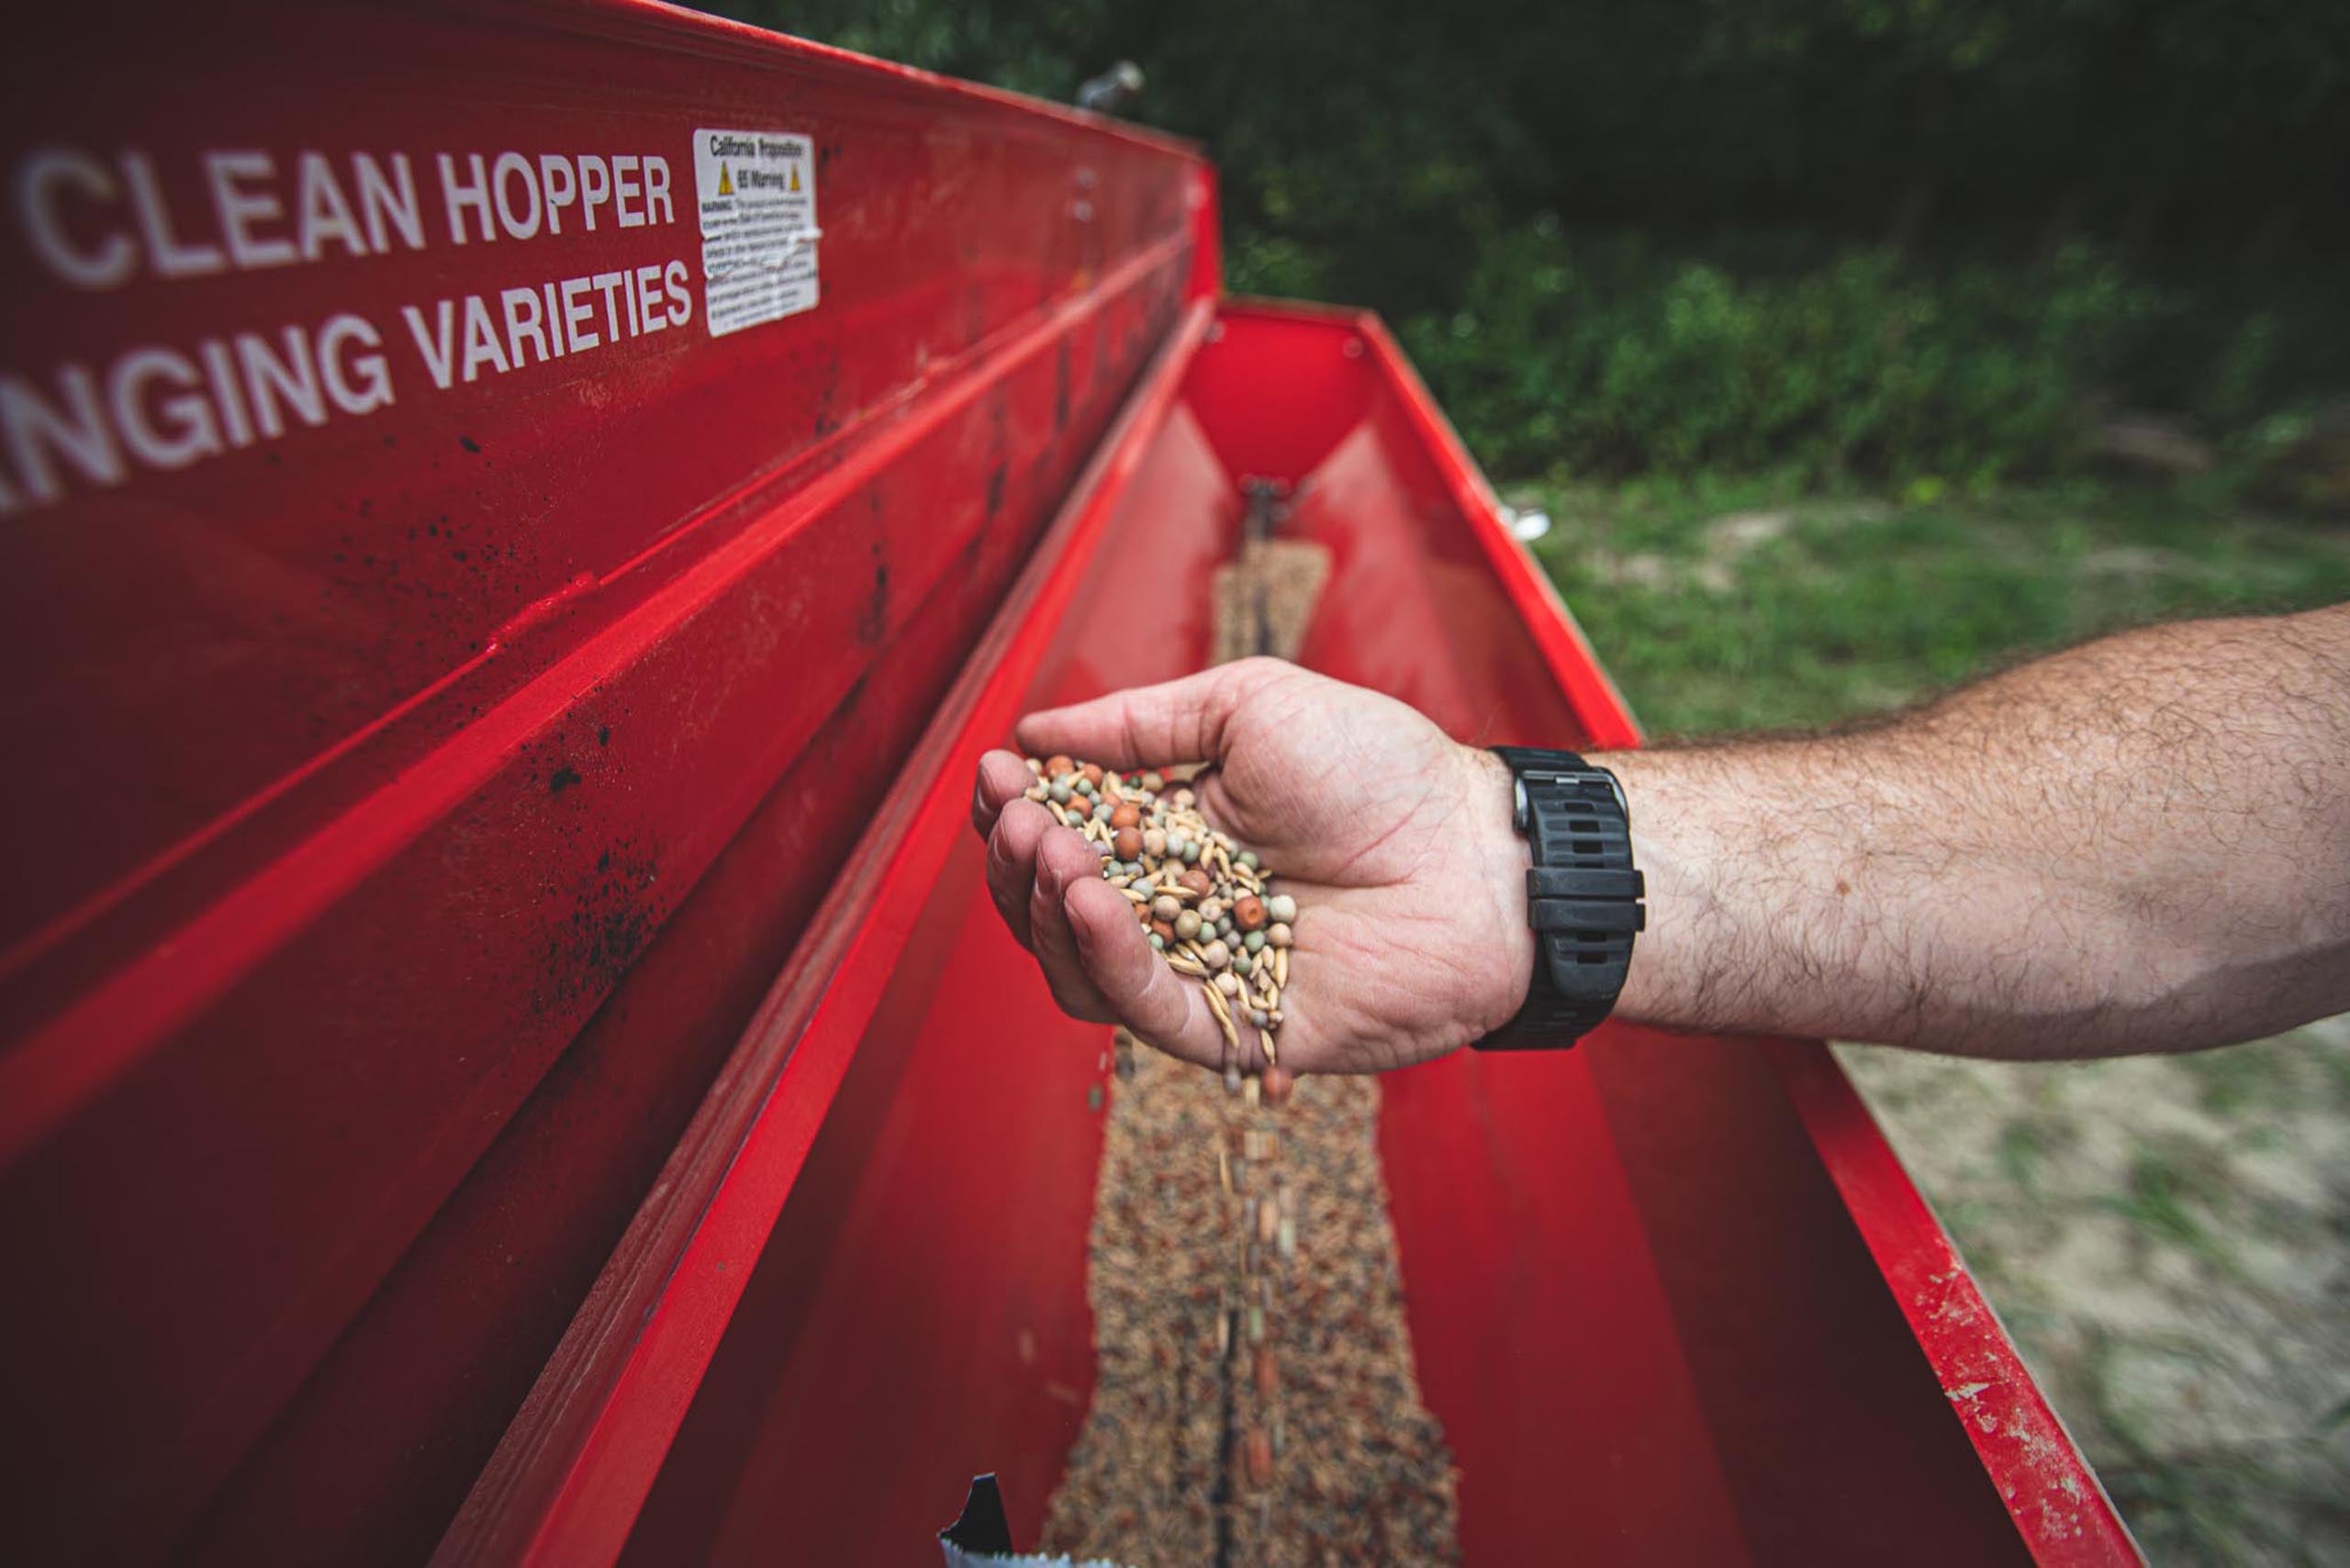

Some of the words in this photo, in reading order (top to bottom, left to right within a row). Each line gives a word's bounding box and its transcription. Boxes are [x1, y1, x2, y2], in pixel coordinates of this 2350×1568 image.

[20, 147, 428, 288] CLEAN
[435, 151, 676, 245] HOPPER
[402, 260, 694, 390] VARIETIES
